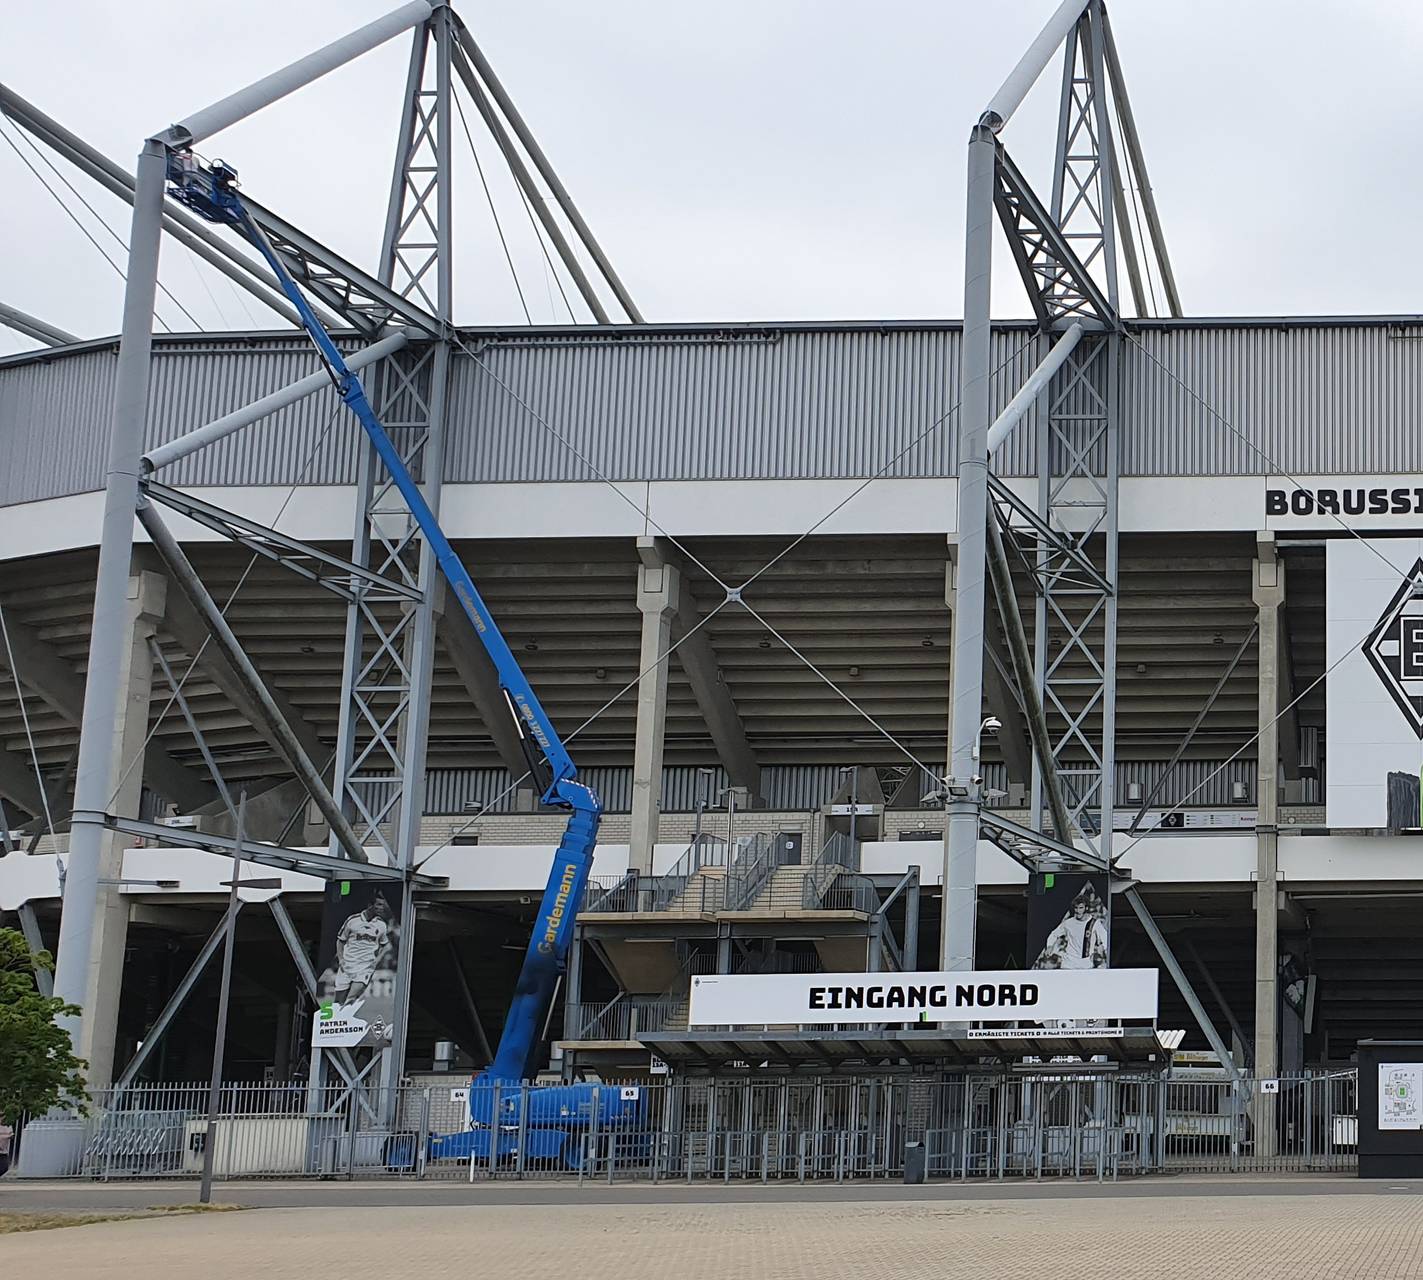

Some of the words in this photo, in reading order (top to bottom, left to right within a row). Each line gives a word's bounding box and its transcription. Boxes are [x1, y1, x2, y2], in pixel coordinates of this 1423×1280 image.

[809, 985, 947, 1010] EINGANG
[955, 983, 1039, 1007] NORD
[319, 1026, 364, 1035] ANDERSSON
